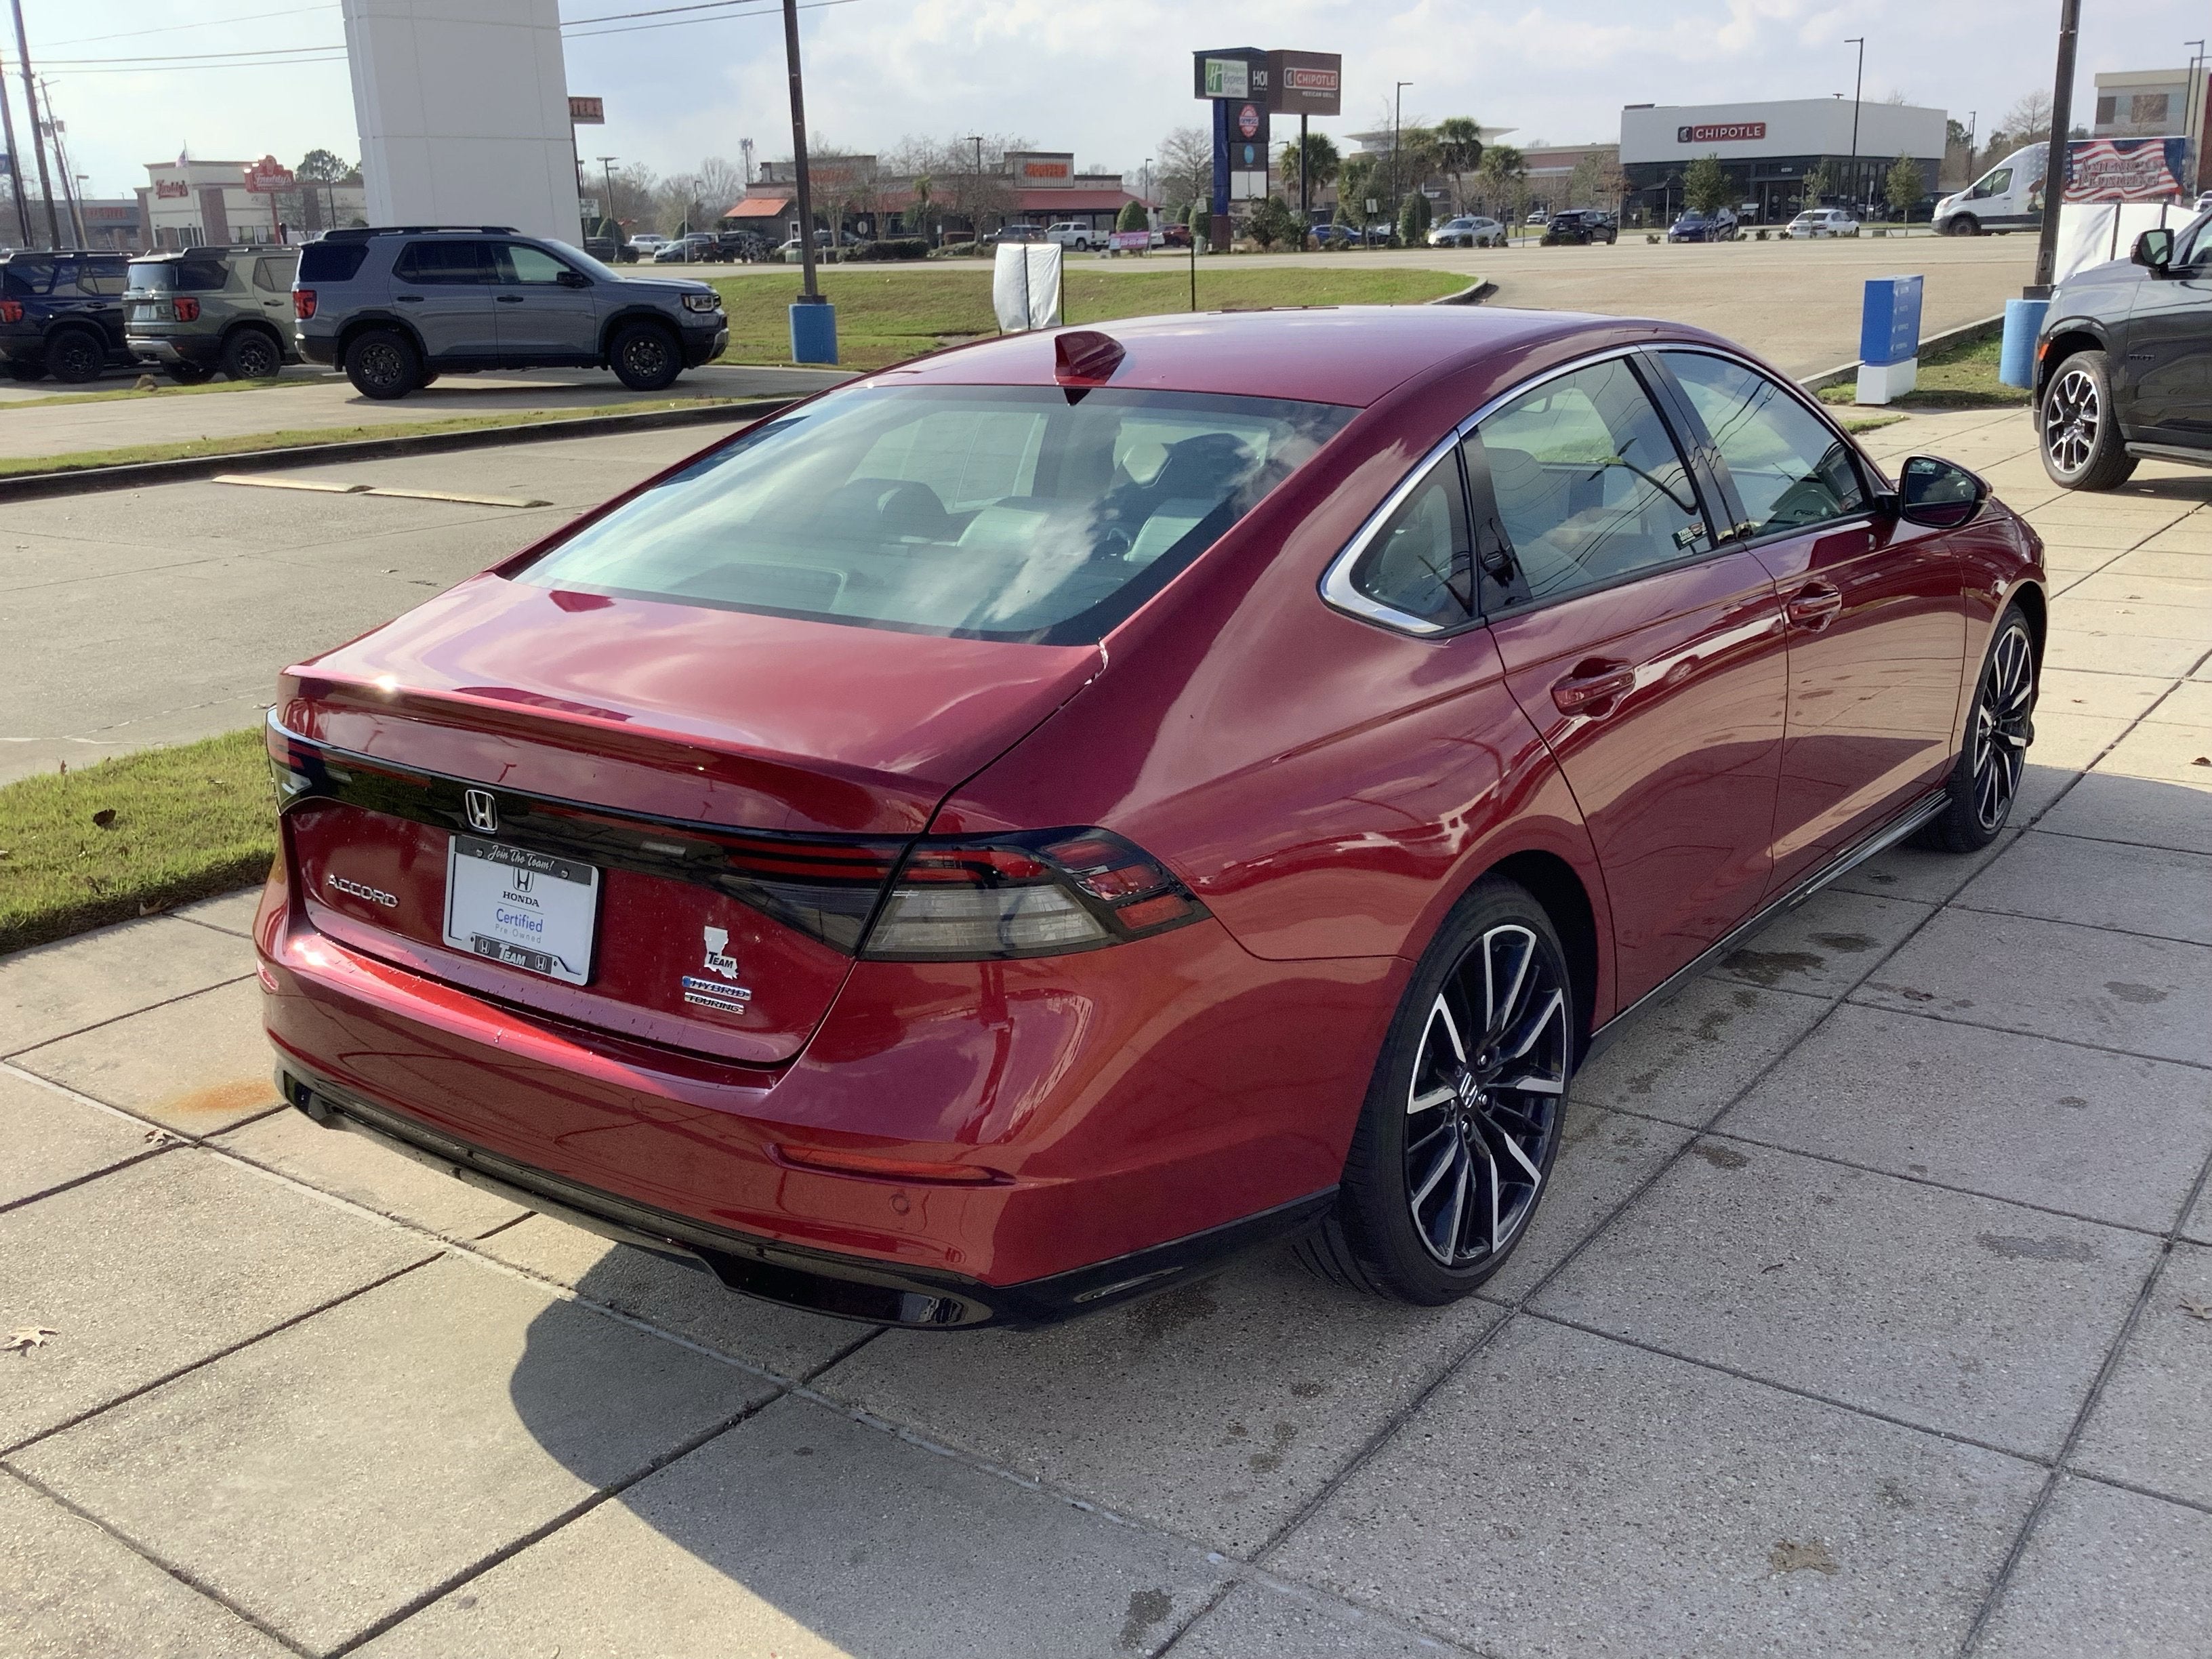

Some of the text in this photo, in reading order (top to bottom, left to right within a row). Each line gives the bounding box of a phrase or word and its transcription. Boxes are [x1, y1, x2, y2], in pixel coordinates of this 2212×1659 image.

[1296, 73, 1335, 85] CHIPOTLE
[1696, 125, 1762, 139] CHIPOTLE
[487, 844, 554, 871] Join The Team!
[329, 873, 398, 907] ACCORD
[503, 890, 539, 907] HONDA
[496, 908, 544, 933] Certified
[495, 924, 542, 943] Pre Owned
[691, 980, 747, 998] HYBRID
[689, 995, 739, 1012] TOURING
